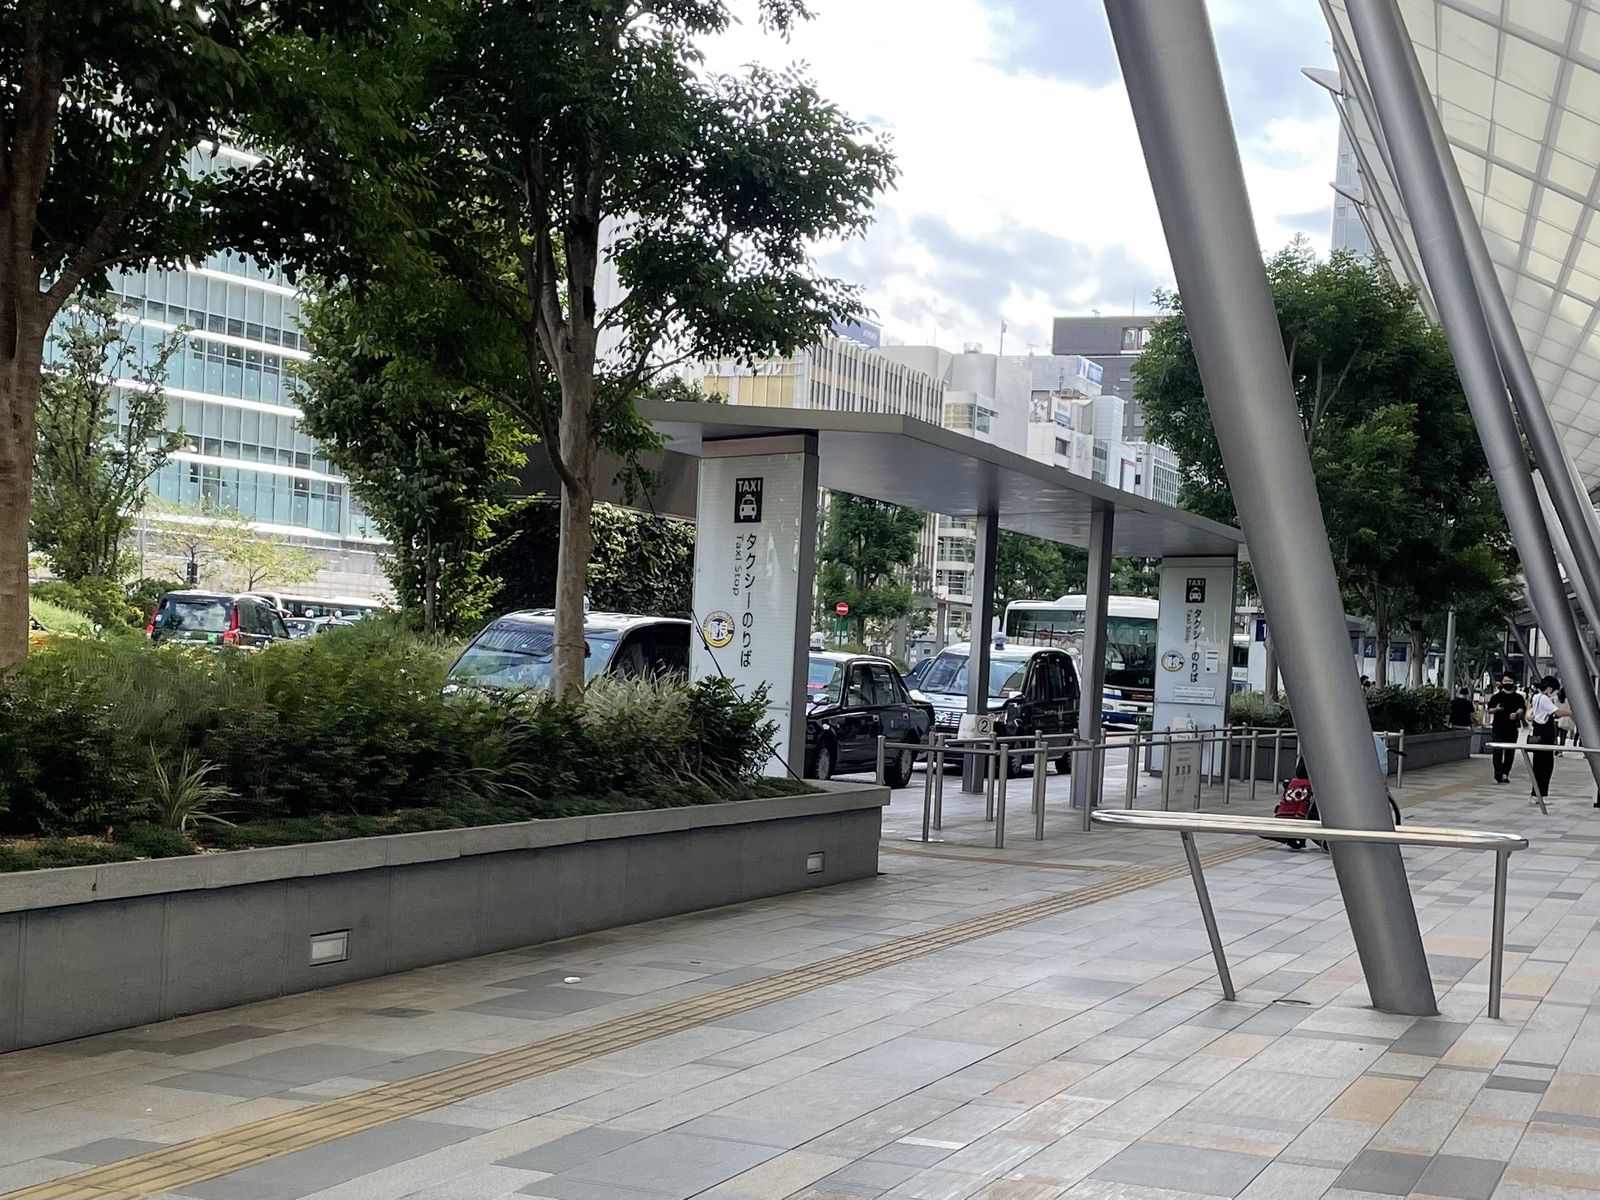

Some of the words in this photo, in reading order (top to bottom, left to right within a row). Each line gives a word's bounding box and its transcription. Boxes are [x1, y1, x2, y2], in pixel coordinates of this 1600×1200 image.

[737, 480, 761, 492] TAXI
[735, 534, 744, 560] Taxi
[732, 566, 742, 596] Stop
[1187, 579, 1205, 587] TAXI
[740, 533, 757, 667] タクシーのりば
[1190, 609, 1202, 683] タクシーのりば
